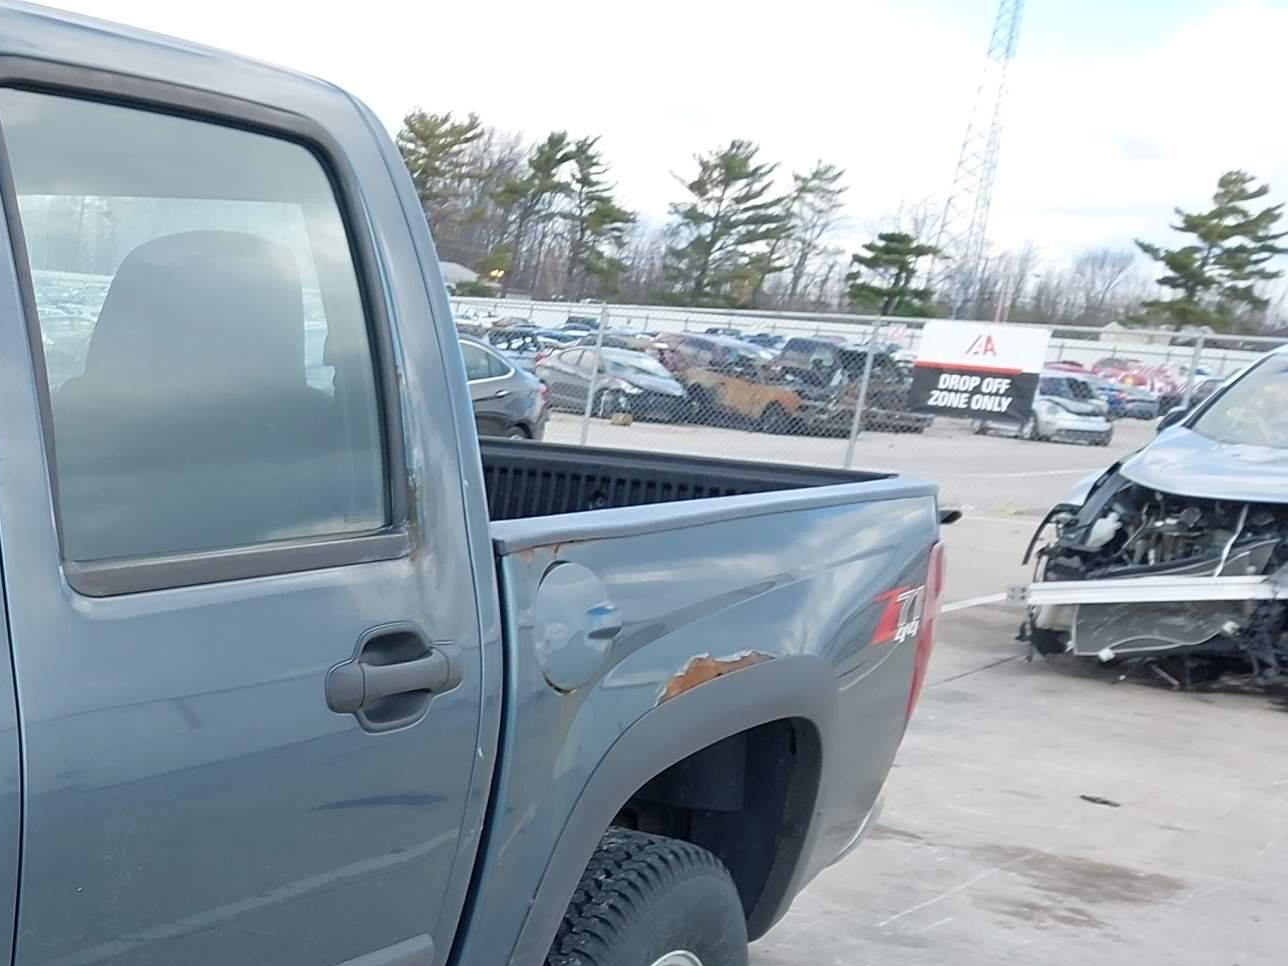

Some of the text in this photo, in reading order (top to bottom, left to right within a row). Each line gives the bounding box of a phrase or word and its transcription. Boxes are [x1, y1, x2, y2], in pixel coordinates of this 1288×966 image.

[937, 373, 1012, 394] DROP OFF
[927, 390, 1013, 412] ZONE ONLY
